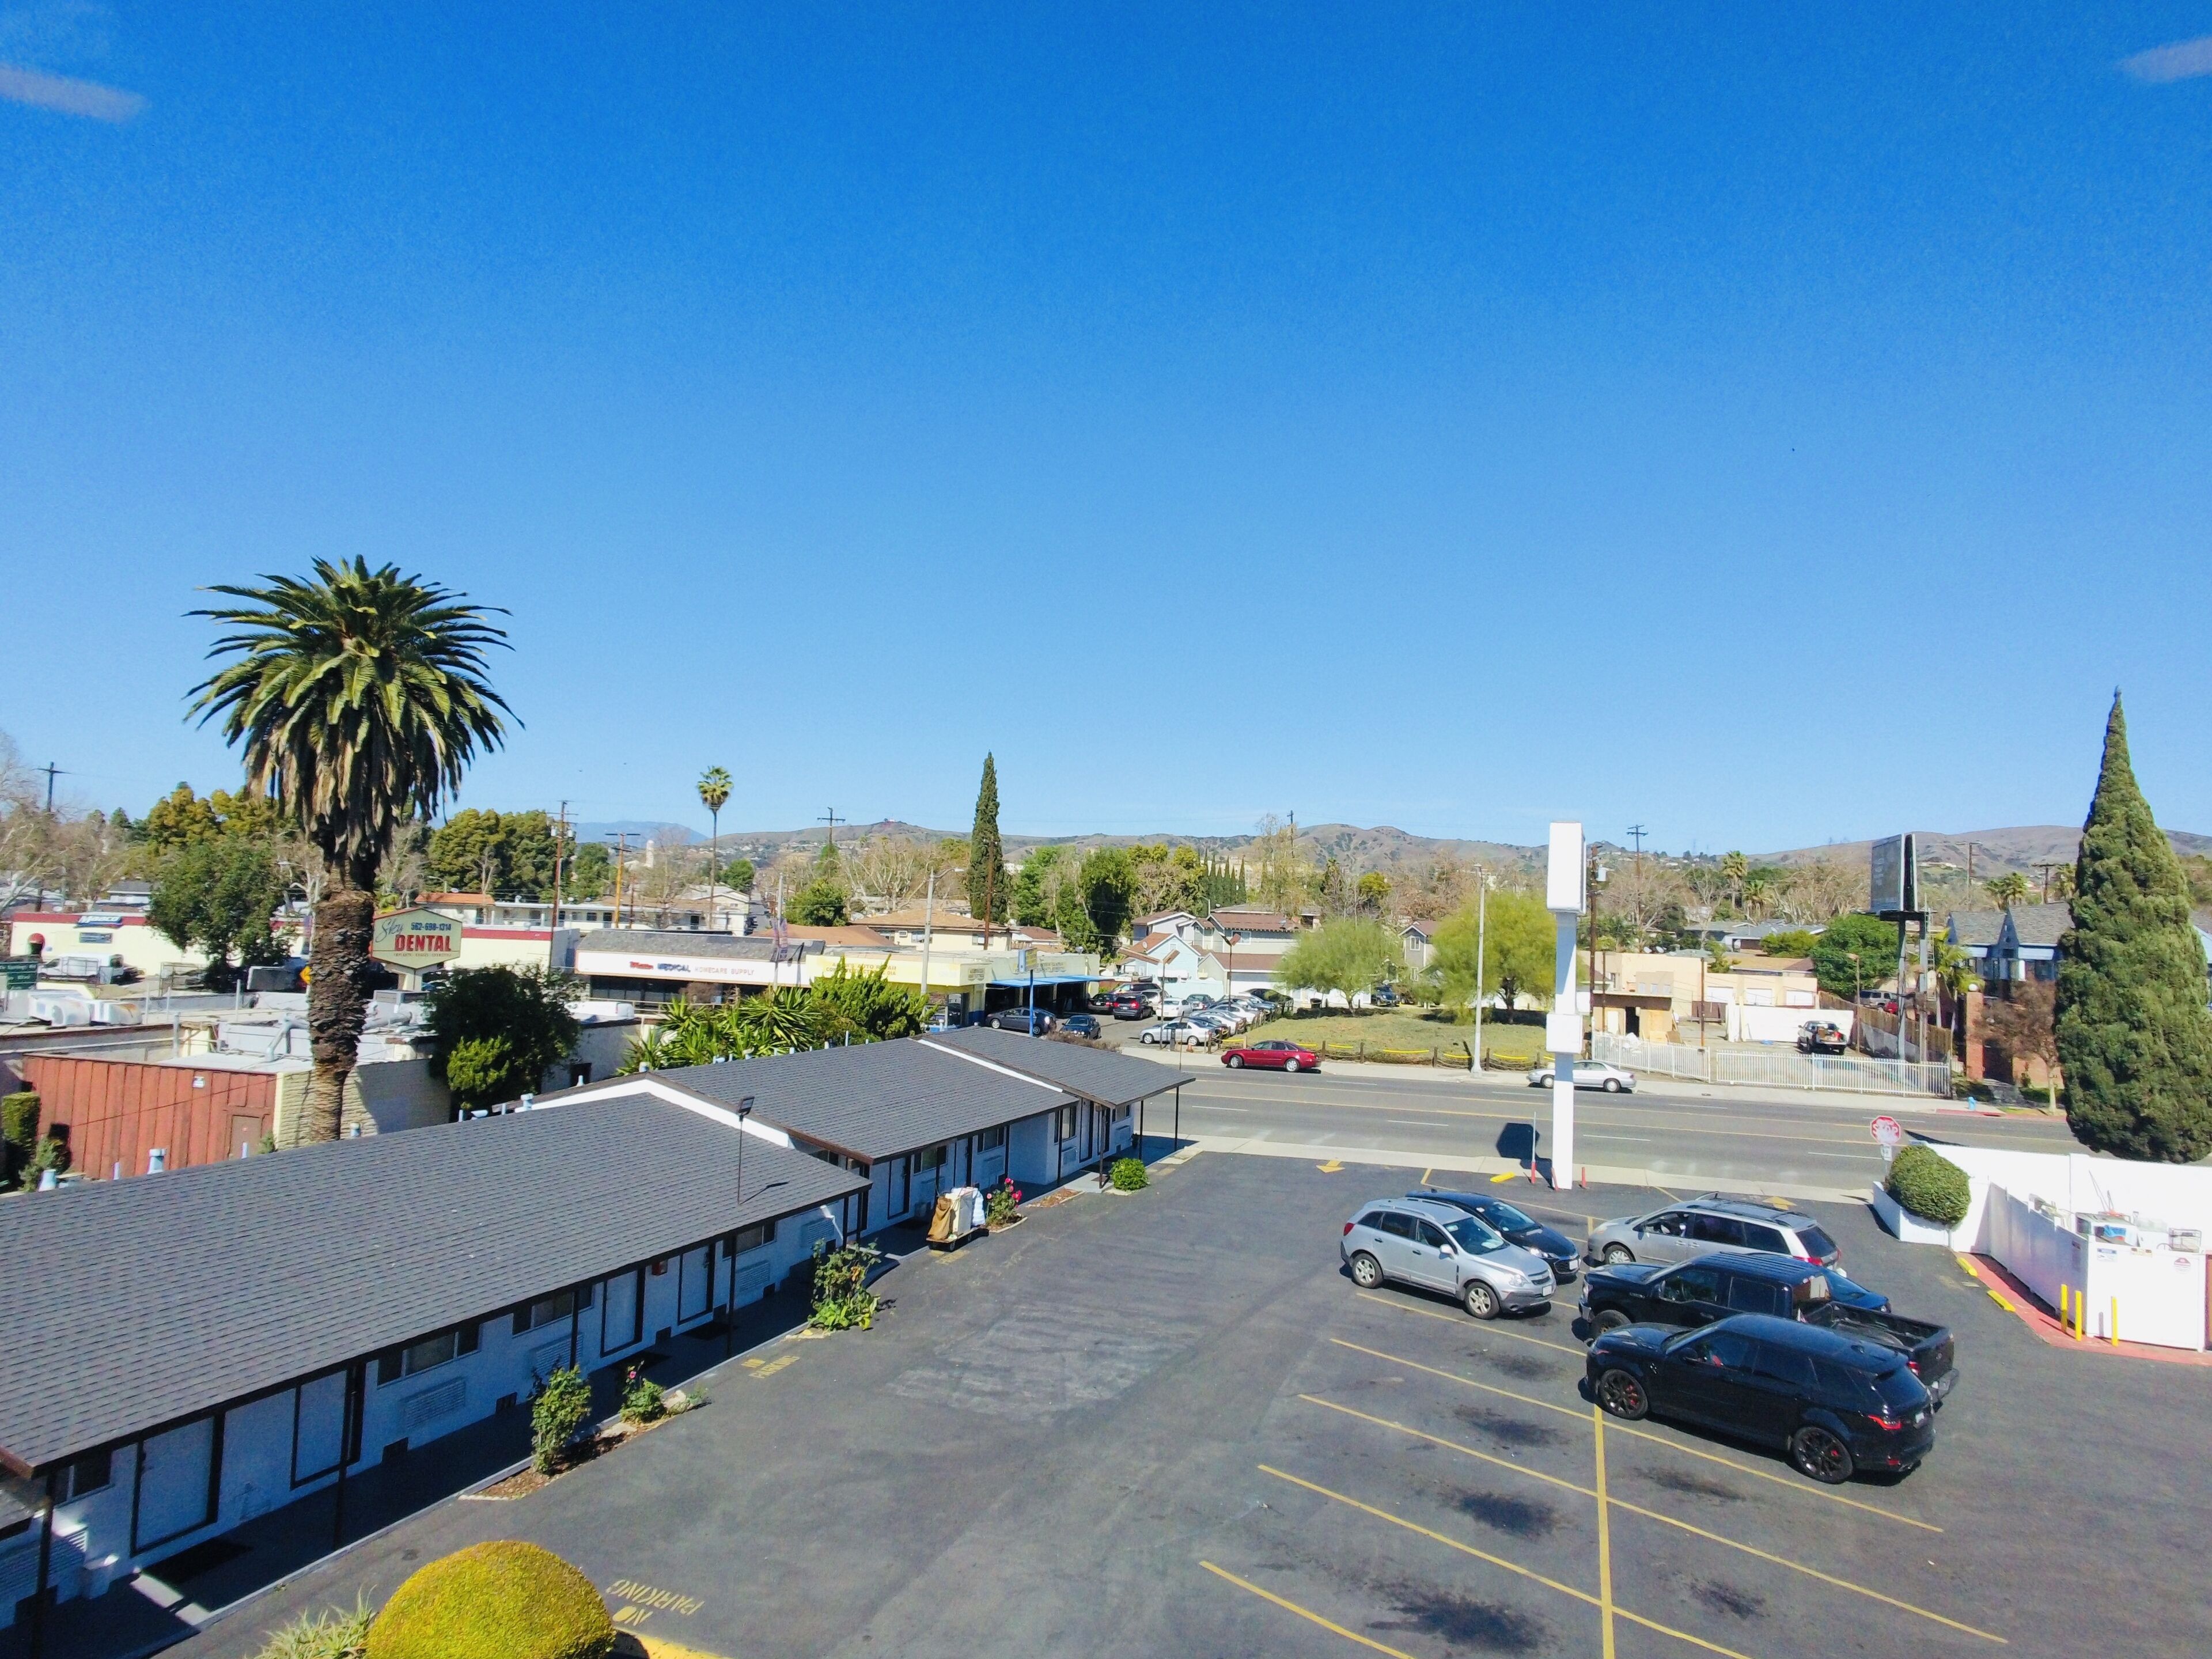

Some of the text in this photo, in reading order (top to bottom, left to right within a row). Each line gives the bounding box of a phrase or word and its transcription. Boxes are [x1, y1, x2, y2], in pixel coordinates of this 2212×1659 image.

[375, 918, 403, 943] Sky
[395, 934, 452, 952] DENTAL
[1872, 1123, 1899, 1137] STOP
[606, 1580, 706, 1616] PARKING
[612, 1605, 654, 1626] NO
